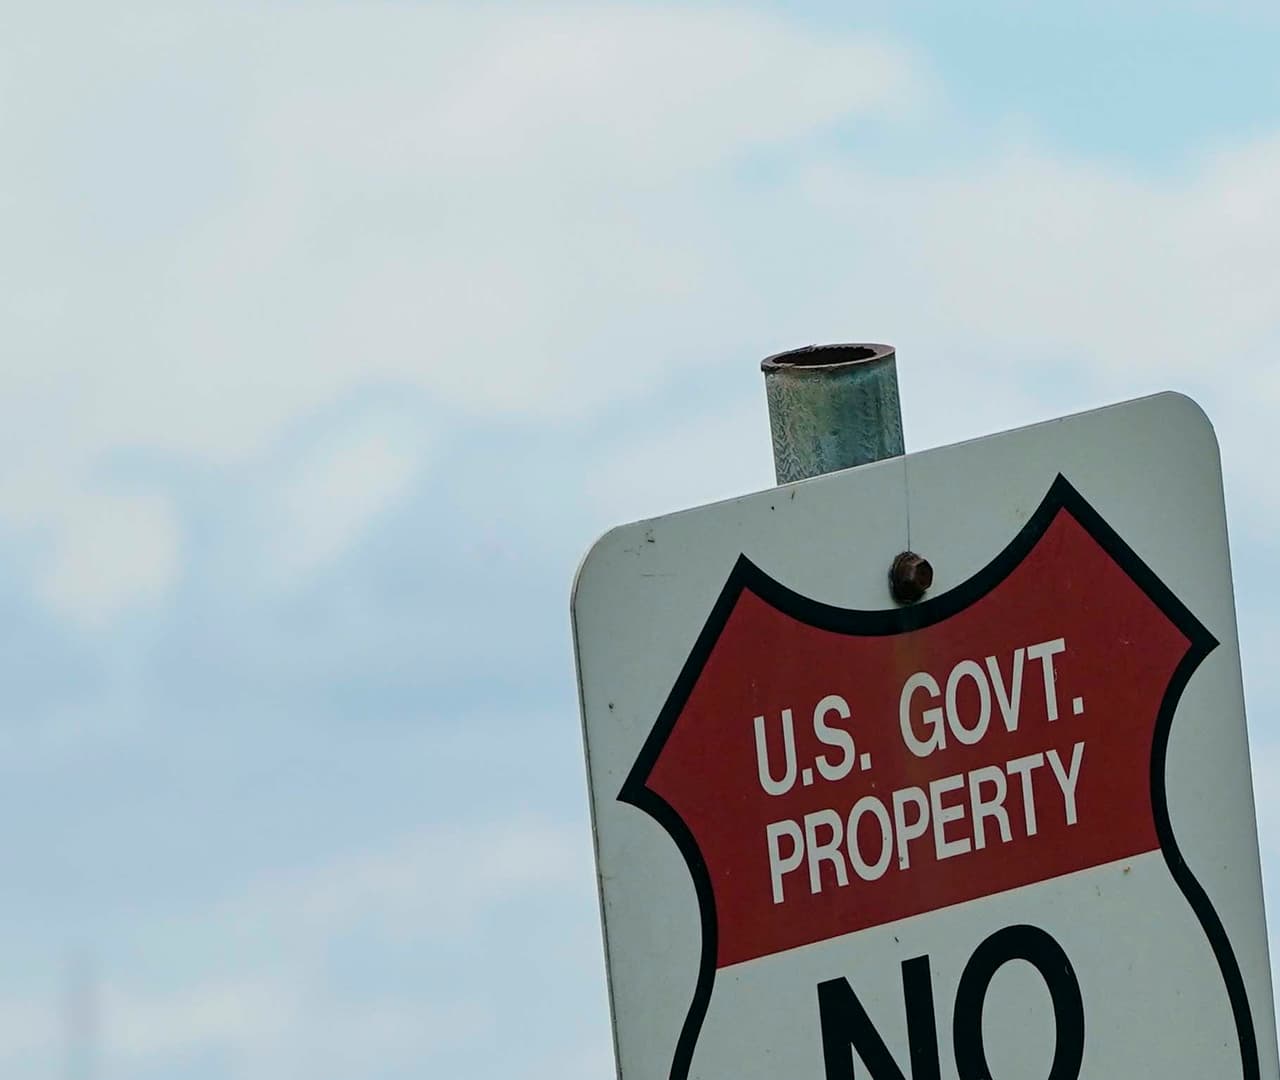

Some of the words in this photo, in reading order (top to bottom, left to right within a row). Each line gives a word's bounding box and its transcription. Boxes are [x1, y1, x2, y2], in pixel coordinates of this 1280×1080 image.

[753, 694, 872, 796] U.S.
[899, 637, 1084, 758] GOVT.
[766, 741, 1085, 904] PROPERTY
